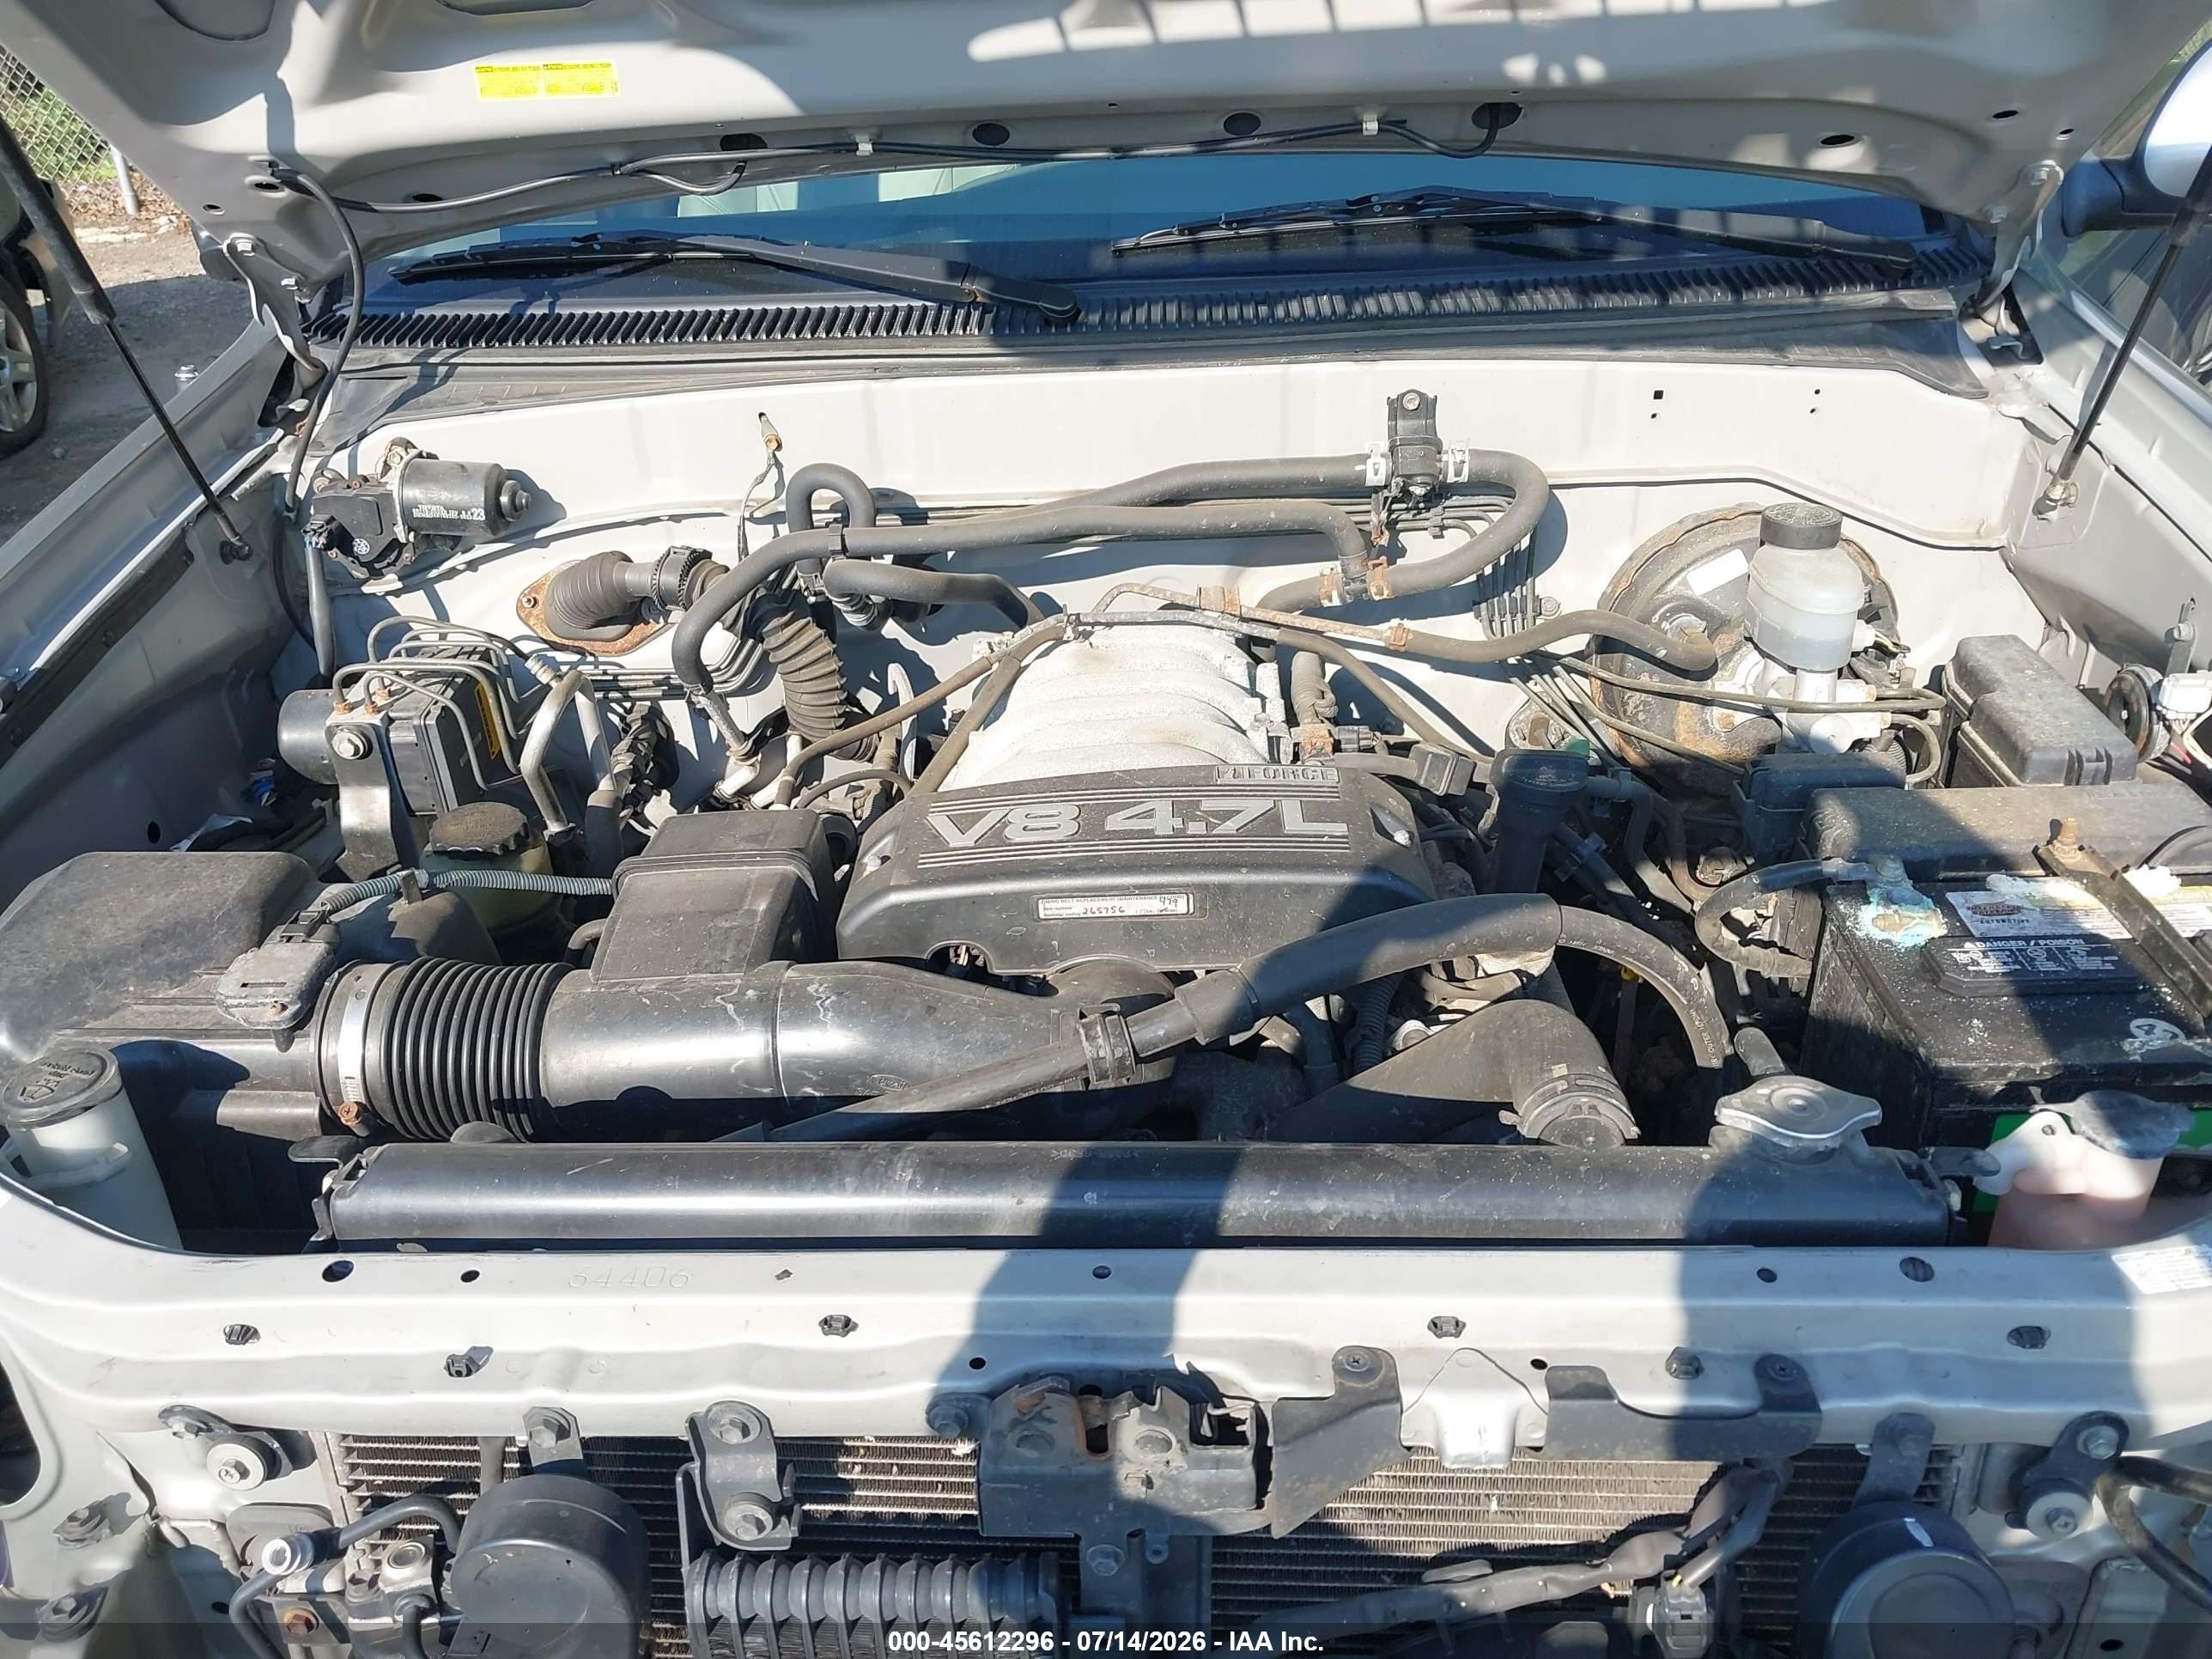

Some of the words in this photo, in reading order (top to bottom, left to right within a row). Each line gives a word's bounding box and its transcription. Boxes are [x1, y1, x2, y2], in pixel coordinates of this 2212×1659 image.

[927, 804, 1081, 848] V8
[1105, 799, 1349, 836] 4.7L
[1082, 906, 1126, 915] 265756
[1975, 939, 2027, 948] DANGER
[568, 1265, 692, 1289] 54406
